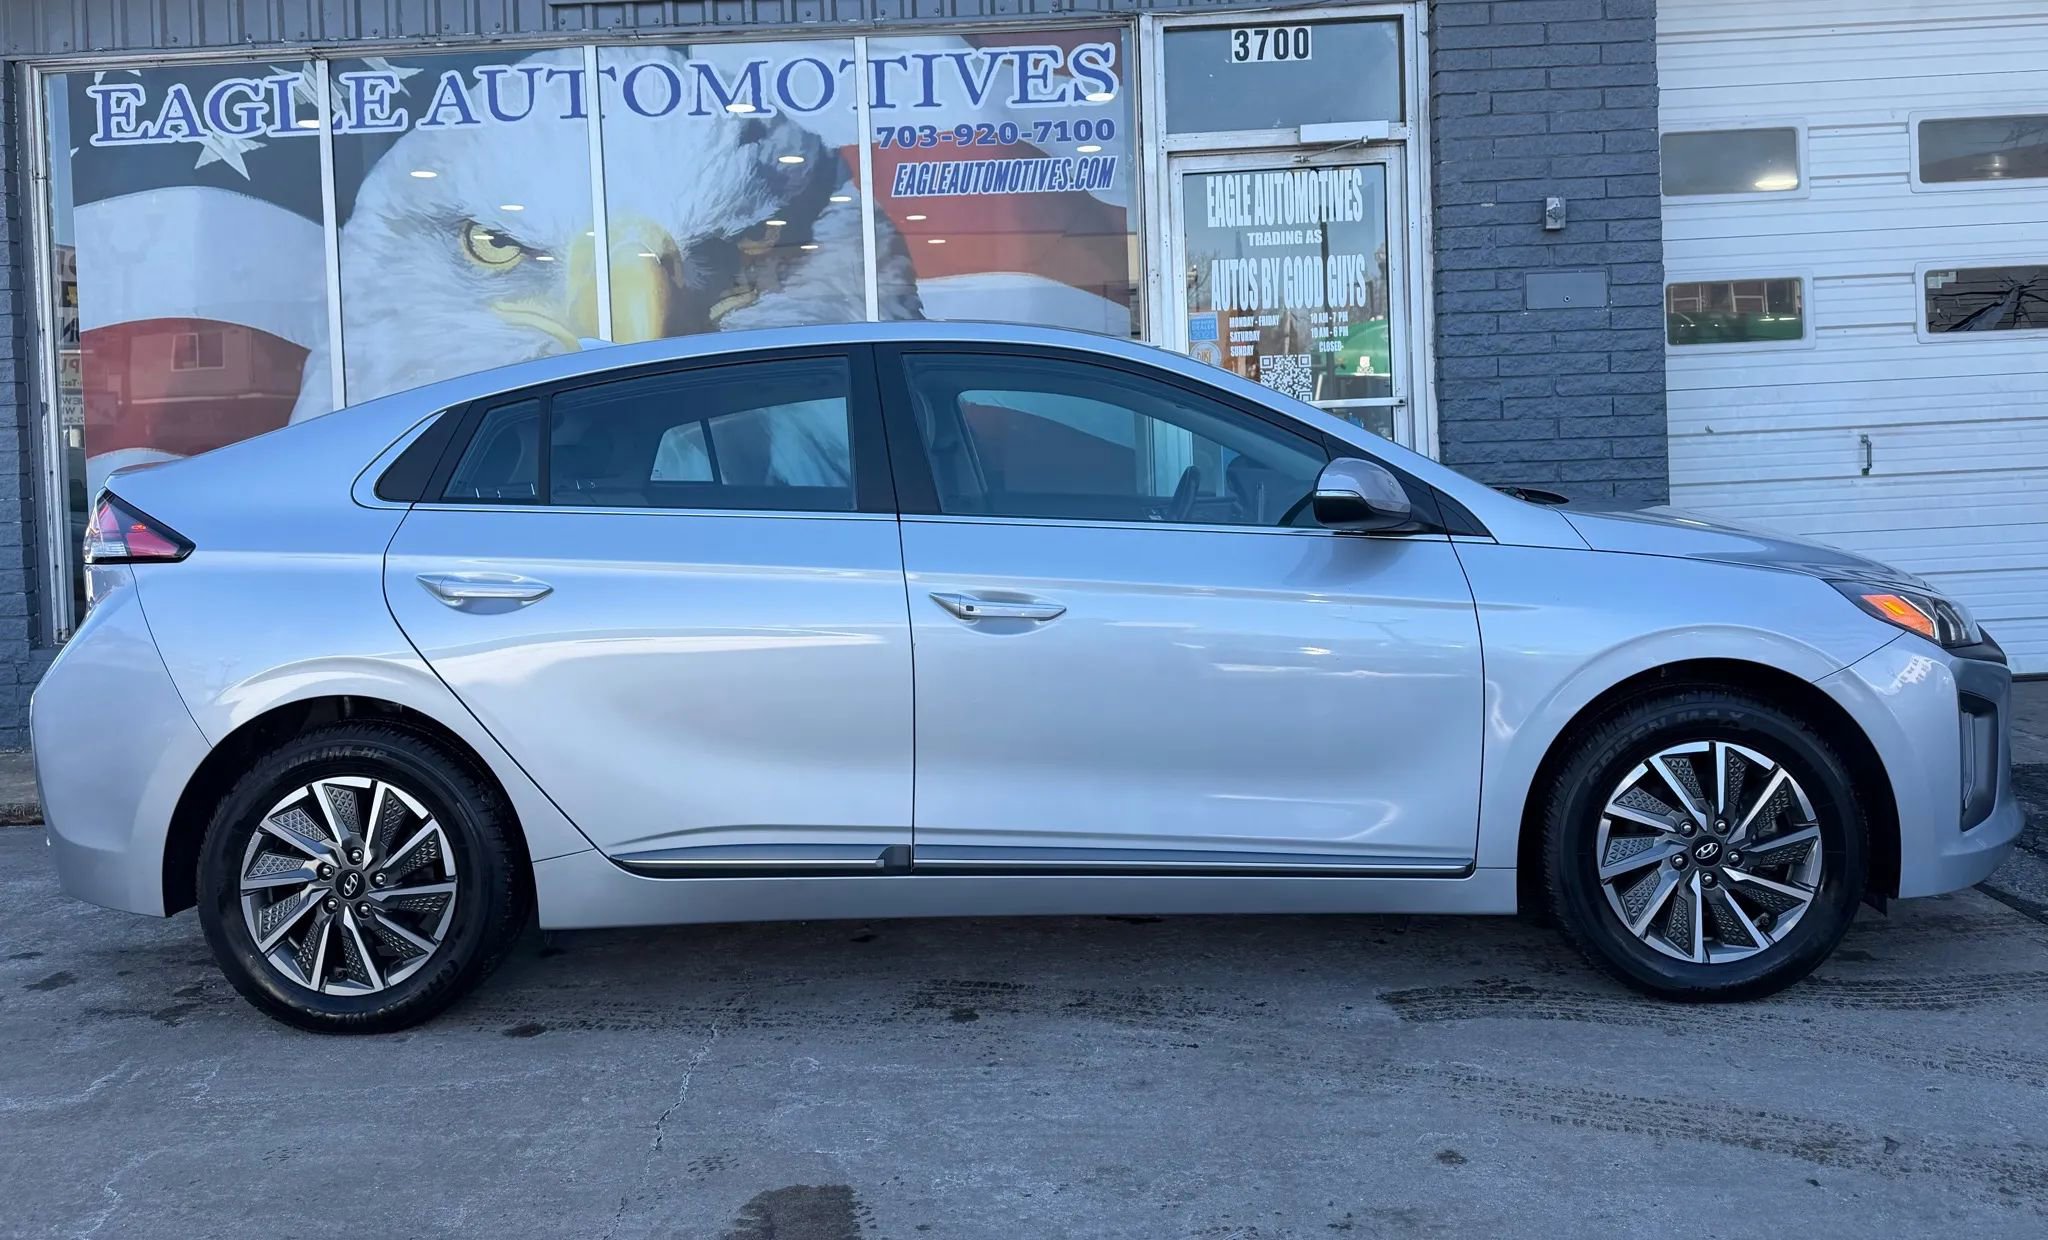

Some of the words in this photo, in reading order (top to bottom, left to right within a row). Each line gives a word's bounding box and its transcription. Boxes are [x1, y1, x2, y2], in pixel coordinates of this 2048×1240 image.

[1234, 27, 1309, 61] 3700
[88, 70, 407, 146] EAGLE
[416, 42, 1122, 131] AUTOMOTIVES
[876, 119, 1116, 149] 703-920-7100
[892, 155, 1118, 197] EAGLEAUTOMOTIVES.COM
[1206, 174, 1252, 228] EAGLE
[1254, 168, 1363, 225] AUTOMOTIVES
[1247, 231, 1303, 247] TRADING
[1306, 230, 1323, 244] AS
[1211, 256, 1259, 312] AUTOS
[1261, 257, 1280, 310] BY
[1283, 256, 1324, 310] GOOD
[1326, 254, 1366, 308] GUYS
[1229, 316, 1255, 328] MONDAY
[1258, 314, 1279, 326] FRIDAY
[1311, 312, 1318, 324] 10
[1318, 312, 1329, 323] AM
[1332, 312, 1337, 323] 7
[1338, 311, 1348, 323] PM
[1229, 330, 1260, 343] SATURDAY
[1318, 326, 1329, 337] AM
[1338, 325, 1348, 337] PM
[1230, 345, 1254, 357] SUNDAY
